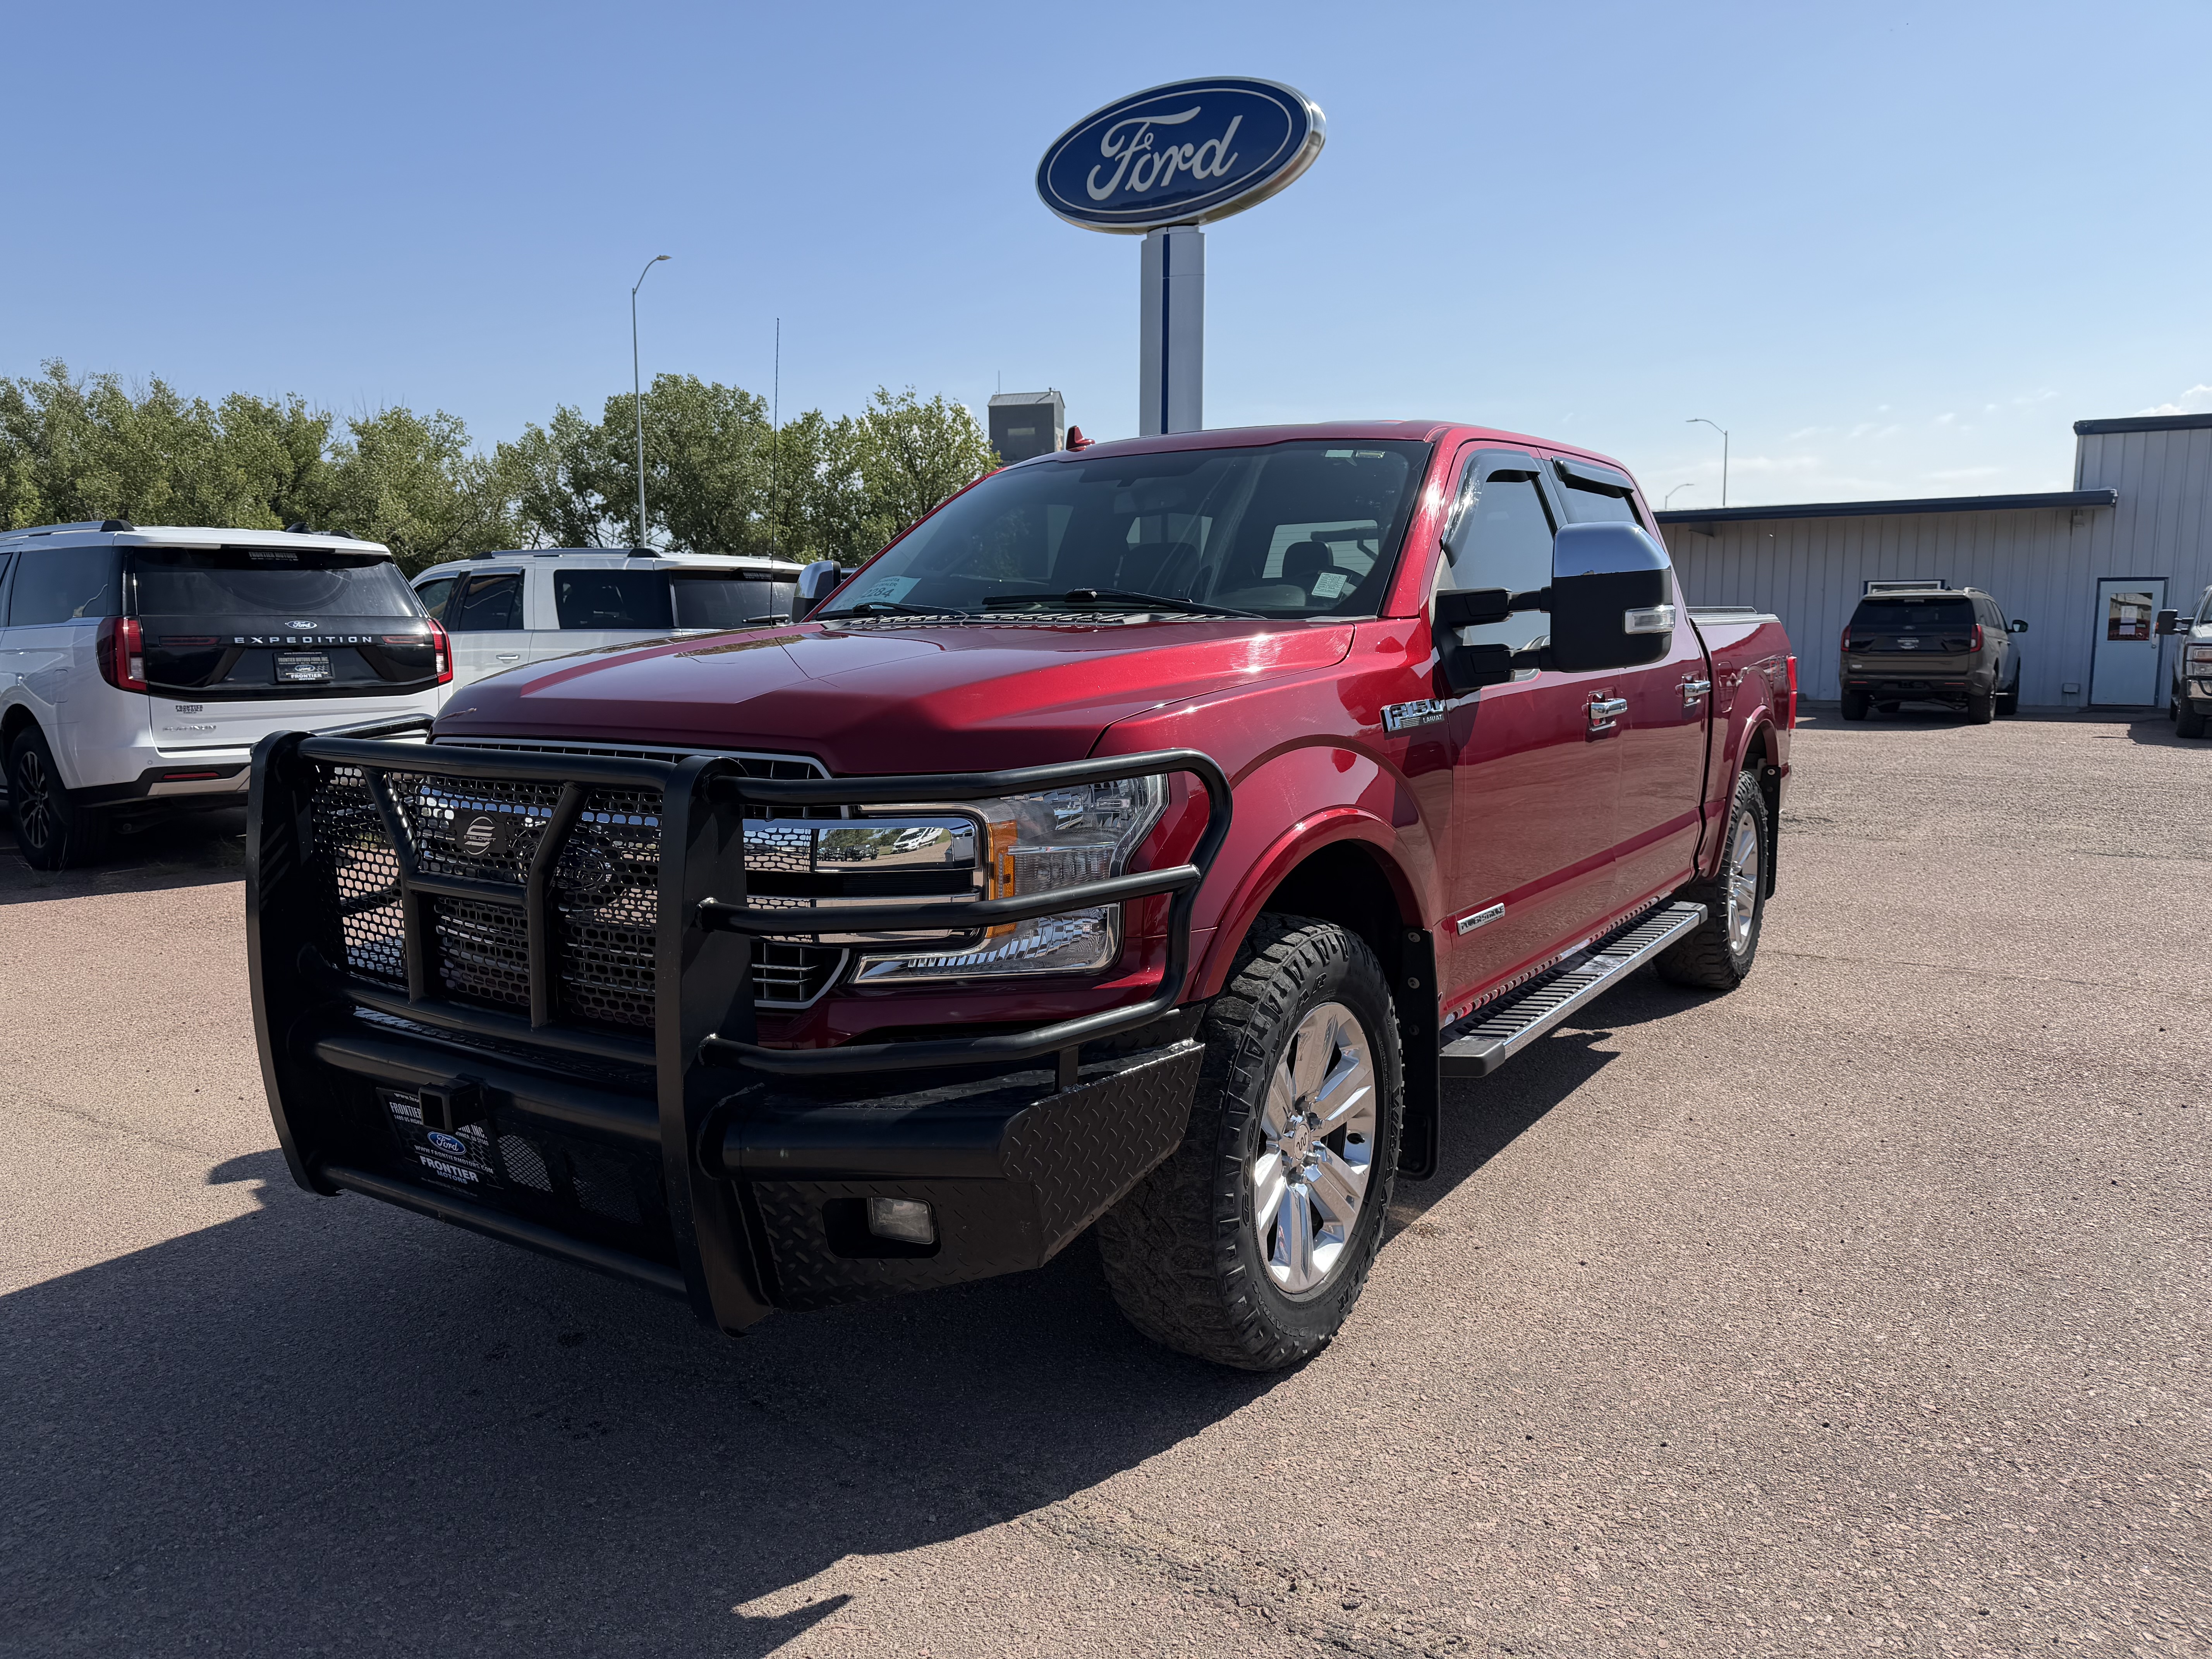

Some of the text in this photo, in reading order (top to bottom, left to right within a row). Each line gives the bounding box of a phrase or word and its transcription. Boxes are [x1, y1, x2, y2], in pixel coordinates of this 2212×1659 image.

[1086, 106, 1243, 201] Ford
[860, 587, 895, 598] 2284
[1423, 714, 1442, 723] LARIAT
[1242, 972, 1327, 1227] GOODYEAR
[436, 1134, 459, 1151] Ford
[414, 1144, 494, 1174] WWW.FRONTIERMOTORS.COM
[419, 1155, 479, 1182] FRONTIER
[436, 1170, 468, 1184] MOTORS
